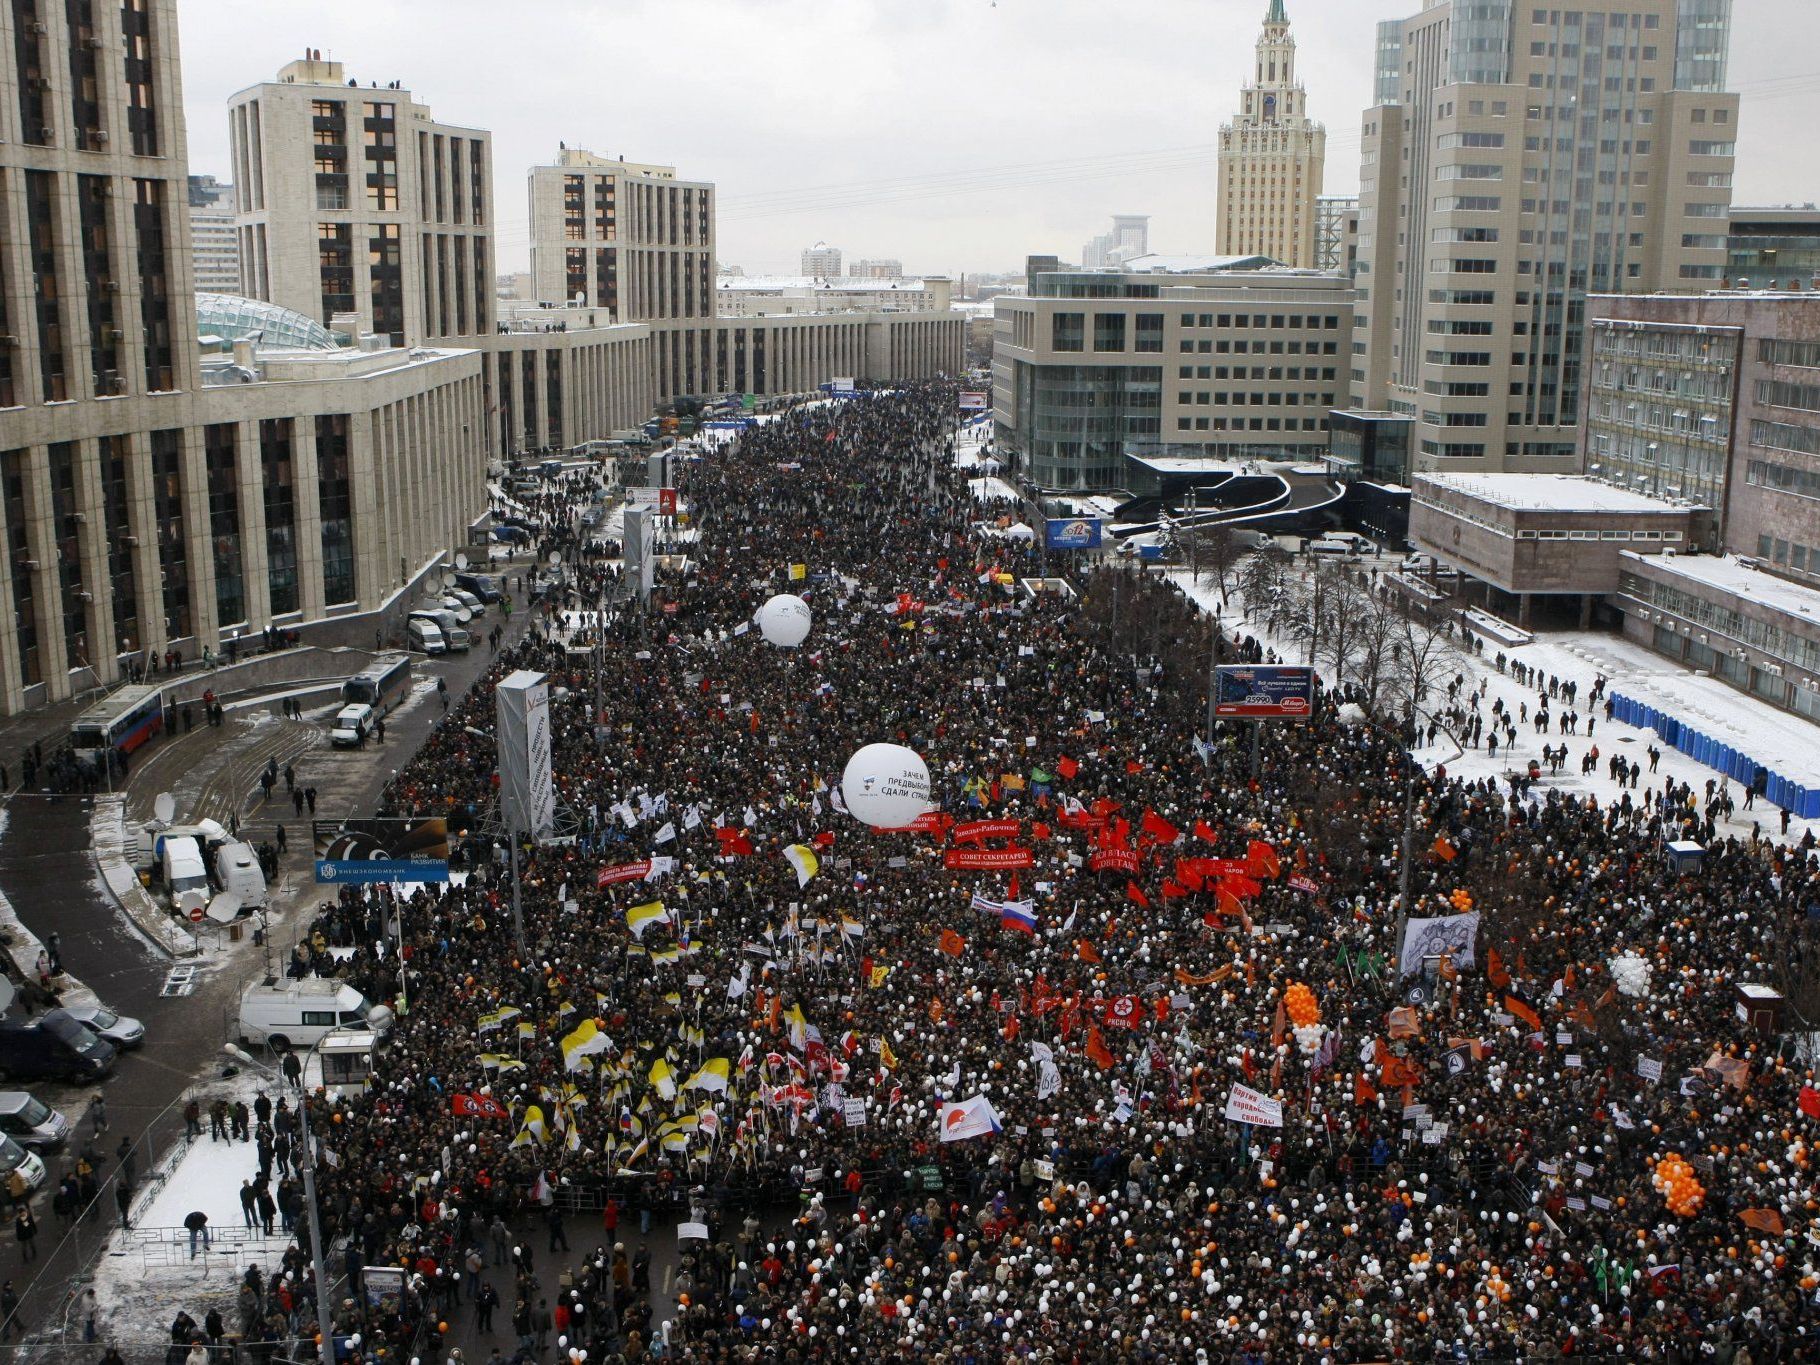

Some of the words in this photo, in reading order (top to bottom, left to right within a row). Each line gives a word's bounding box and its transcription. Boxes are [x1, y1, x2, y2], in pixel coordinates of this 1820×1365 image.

[903, 770, 924, 780] ЗАЧЕМ
[881, 787, 909, 797] СДАЛИ
[983, 852, 1028, 860] СЕКРЕТАРЕЙ
